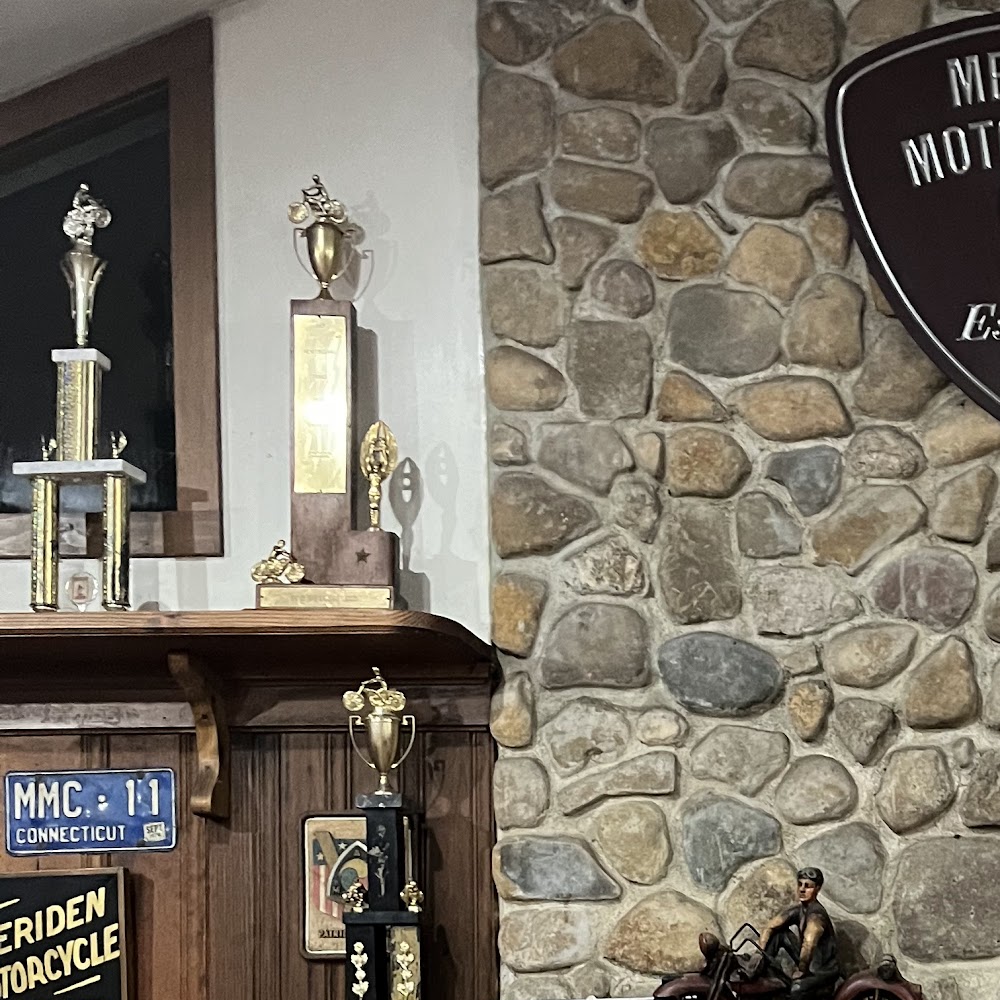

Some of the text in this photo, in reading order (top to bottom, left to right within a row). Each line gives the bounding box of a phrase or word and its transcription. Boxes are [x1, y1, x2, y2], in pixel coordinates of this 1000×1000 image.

[14, 778, 159, 820] MMC 11
[16, 825, 126, 844] CONNECTICUT
[0, 922, 120, 1000] TORCYCLE
